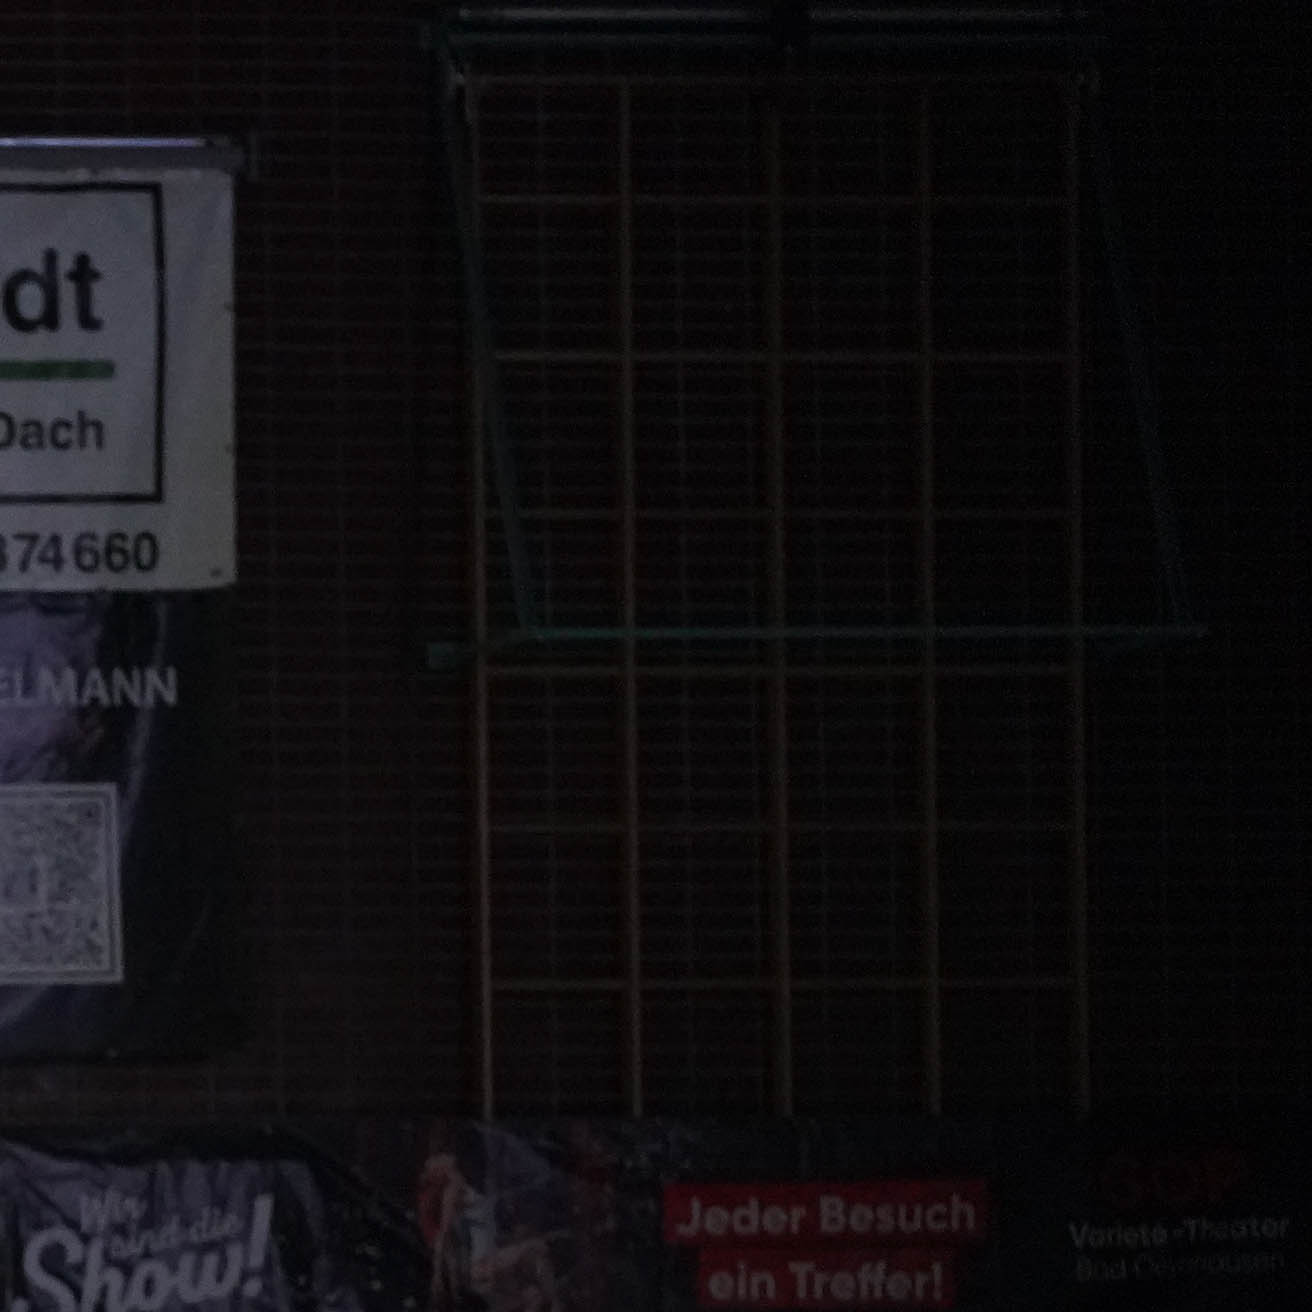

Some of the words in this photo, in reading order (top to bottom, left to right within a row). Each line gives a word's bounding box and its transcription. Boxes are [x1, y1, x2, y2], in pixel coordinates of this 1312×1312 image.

[677, 1195, 808, 1239] Jeder
[819, 1190, 977, 1235] Besuch
[707, 1263, 777, 1302] ein
[788, 1258, 944, 1301] Treffer!
